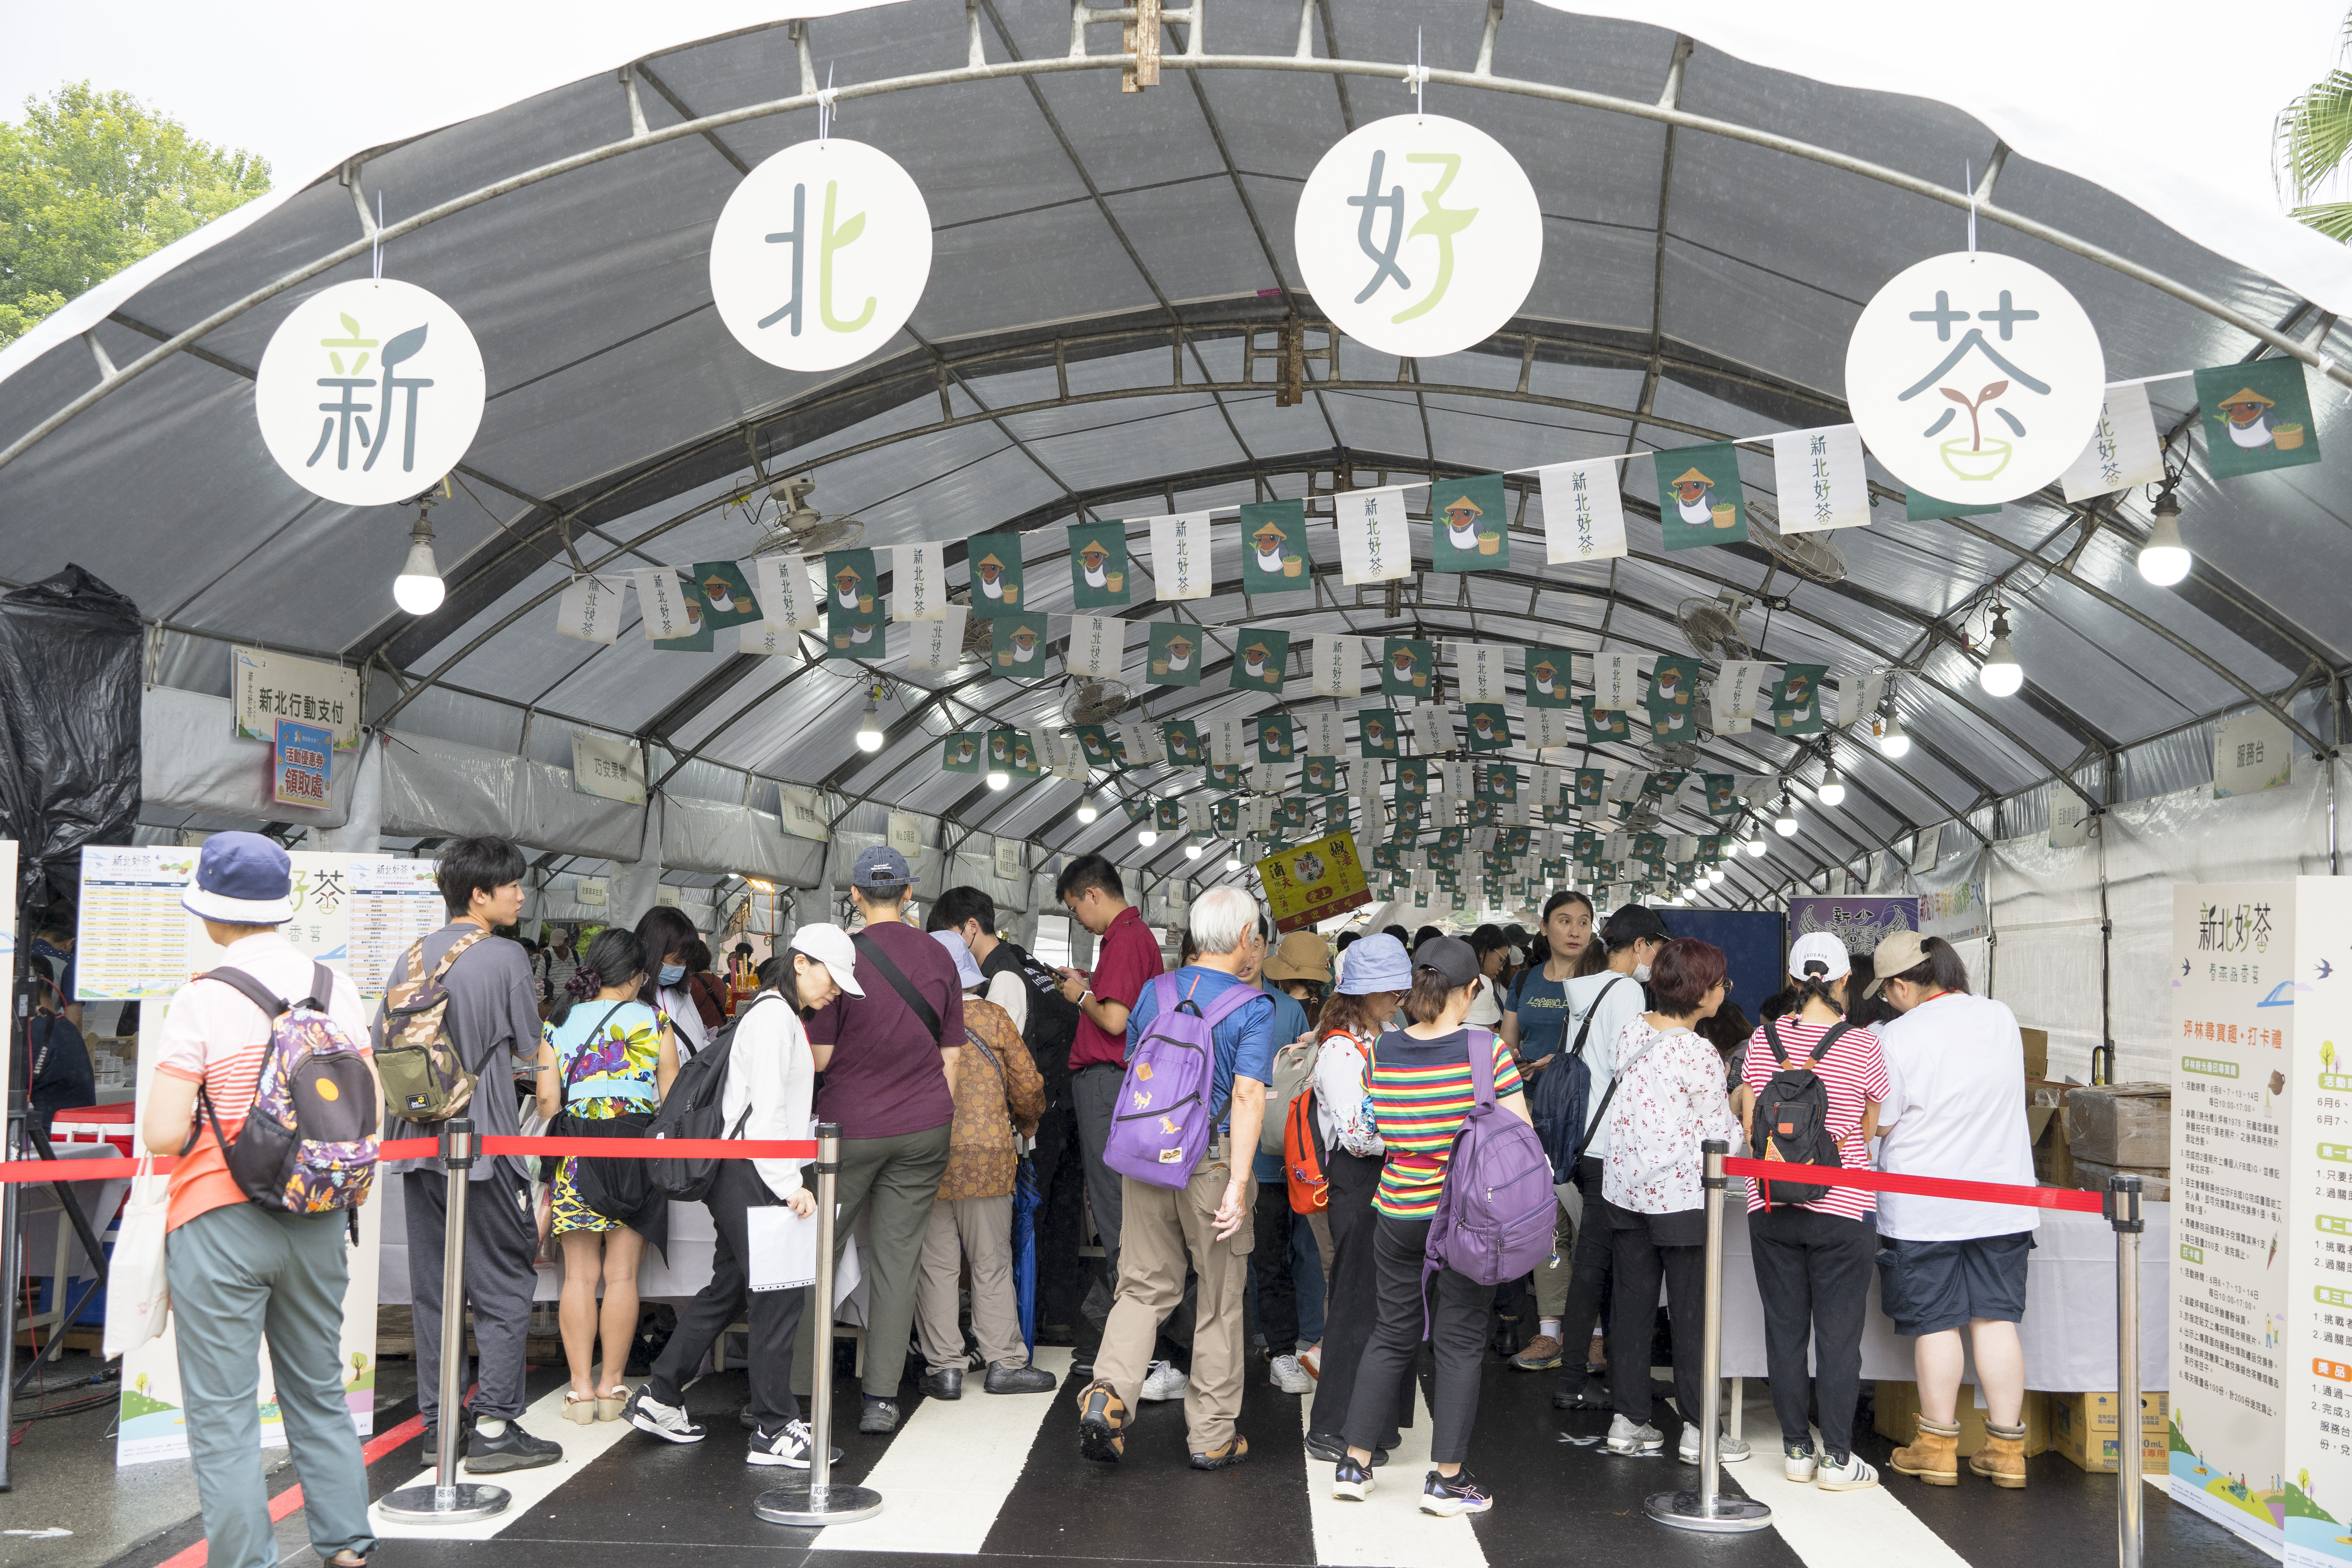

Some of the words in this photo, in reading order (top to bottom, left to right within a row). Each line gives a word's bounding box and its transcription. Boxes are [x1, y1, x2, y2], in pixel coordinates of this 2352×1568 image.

[307, 312, 434, 473] 新
[757, 180, 877, 337] 北
[1347, 150, 1480, 325] 好
[1898, 290, 2051, 481] 茶
[1810, 434, 1833, 524] 新北好茶
[1573, 472, 1594, 556] 新北好茶
[1364, 497, 1383, 577] 新北好茶
[1176, 520, 1189, 593] 新北好茶
[779, 563, 797, 626] 新北好茶
[913, 548, 926, 617] 新北好茶
[654, 574, 672, 635] 新北好茶
[1331, 641, 1342, 693] 新北好茶
[1477, 649, 1488, 700] 新北好茶
[1612, 657, 1621, 708] 新北好茶
[260, 687, 343, 724] 新北行動支付
[1733, 666, 1747, 715] 新北好茶
[1042, 728, 1055, 764] 新北好茶
[1133, 726, 1149, 760] 新北好茶
[1322, 713, 1330, 753] 新北好茶
[1426, 711, 1441, 750] 新北好茶
[286, 746, 323, 769] 活動優惠券
[594, 758, 628, 782] 巧安果物
[1067, 744, 1079, 777] 新北好茶
[2237, 740, 2264, 768] 服務台
[285, 767, 323, 799] 領取處
[1360, 762, 1369, 795] 新北好茶
[1540, 770, 1549, 803] 新北好茶
[1619, 773, 1635, 798] 新北好茶
[113, 854, 151, 867] 新北好茶
[376, 864, 408, 875] 新北好茶
[1294, 898, 1353, 926] 歡迎試吃
[1309, 889, 1330, 903] 愛上
[1833, 907, 1874, 925] 新少
[2198, 902, 2272, 953] 新北好茶
[275, 924, 321, 942] 香茗
[2209, 962, 2259, 984] 春燕品香茗
[2183, 1247, 2200, 1261] 打卡禮
[2318, 1361, 2345, 1378] 獎品
[2320, 1420, 2352, 1438] 服務台
[2320, 1438, 2352, 1456] 份，兌
